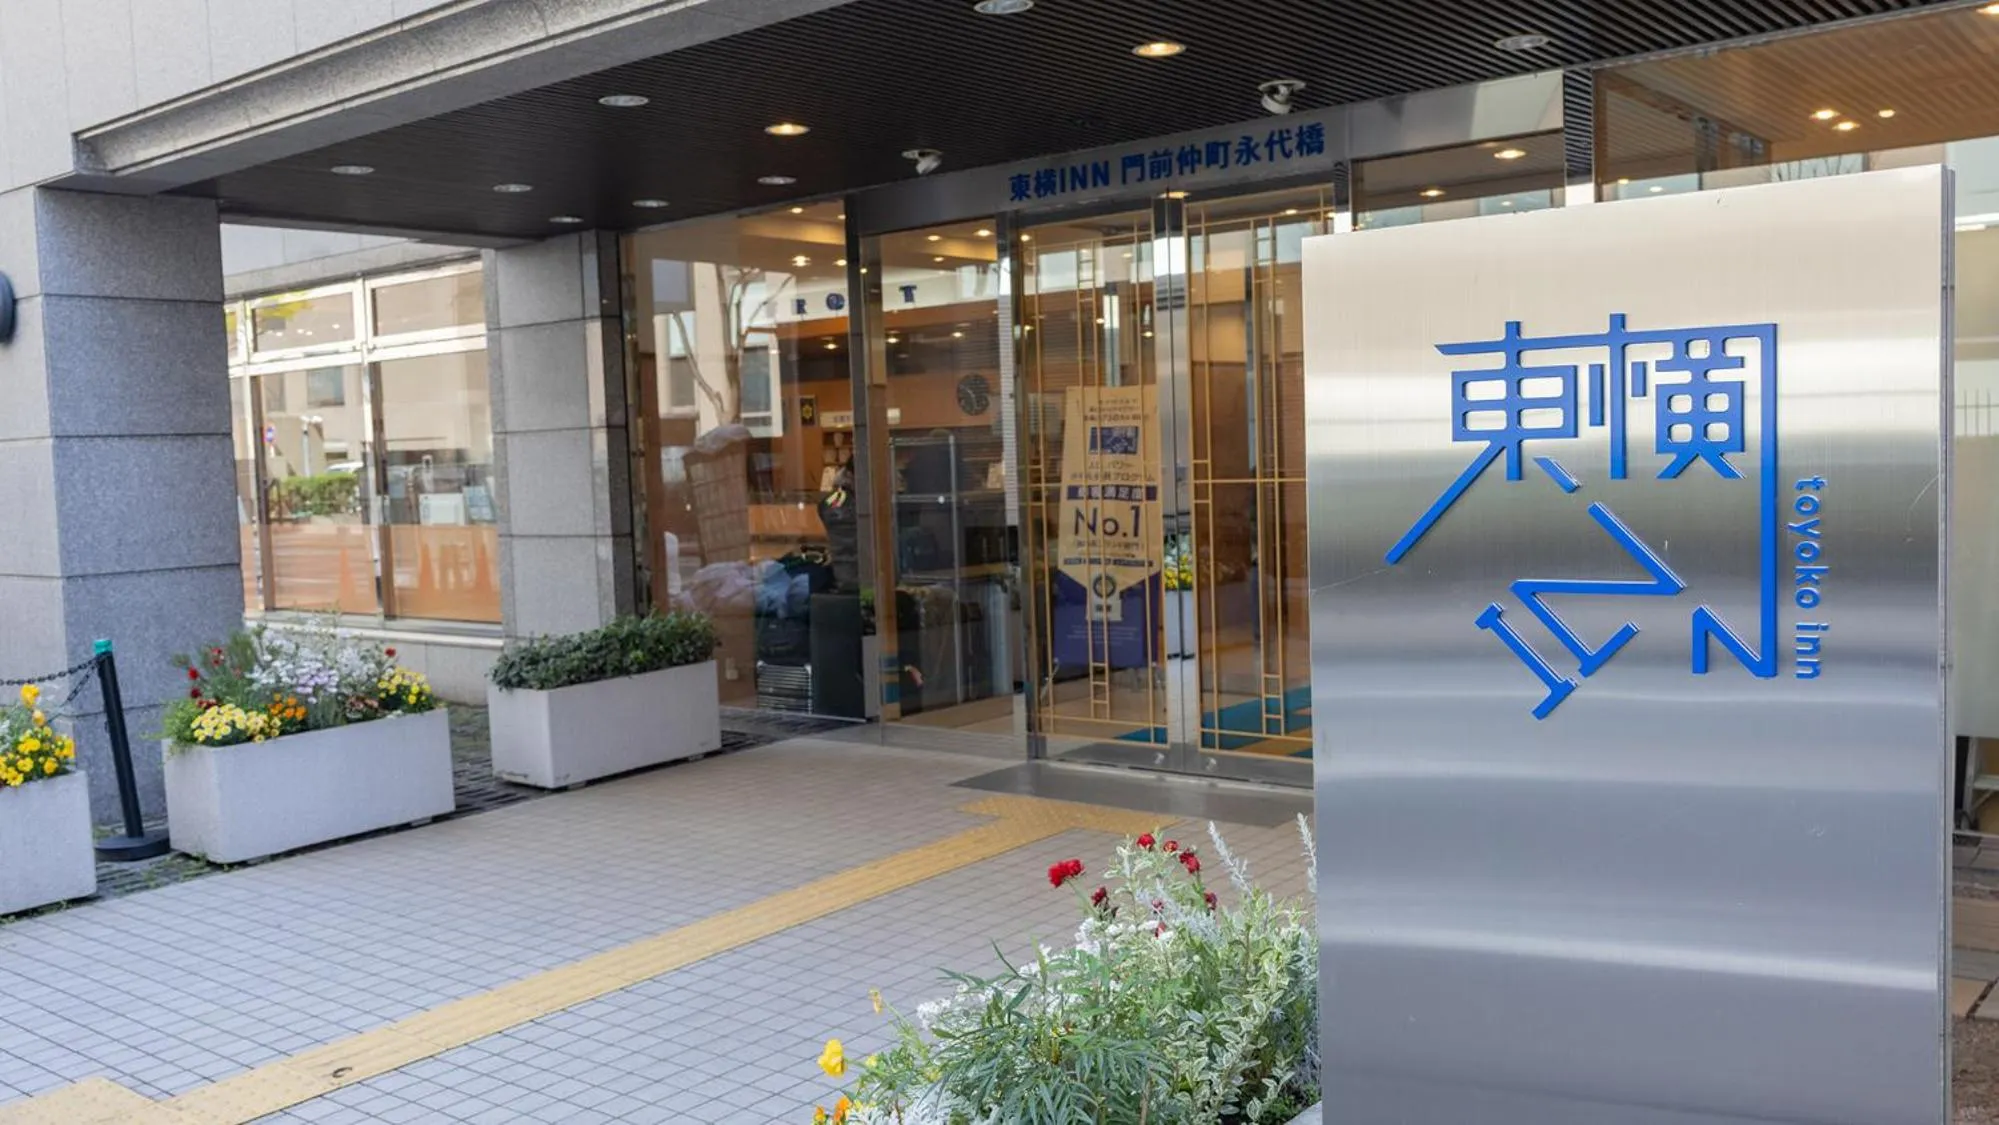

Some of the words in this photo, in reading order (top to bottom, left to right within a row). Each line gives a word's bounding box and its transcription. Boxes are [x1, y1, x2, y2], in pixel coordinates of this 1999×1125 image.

[1008, 161, 1110, 201] 東横INN
[1121, 122, 1325, 184] 門前仲町永代橋
[1074, 505, 1141, 538] No.1
[1787, 475, 1829, 609] toyoko
[1795, 622, 1829, 679] inn
